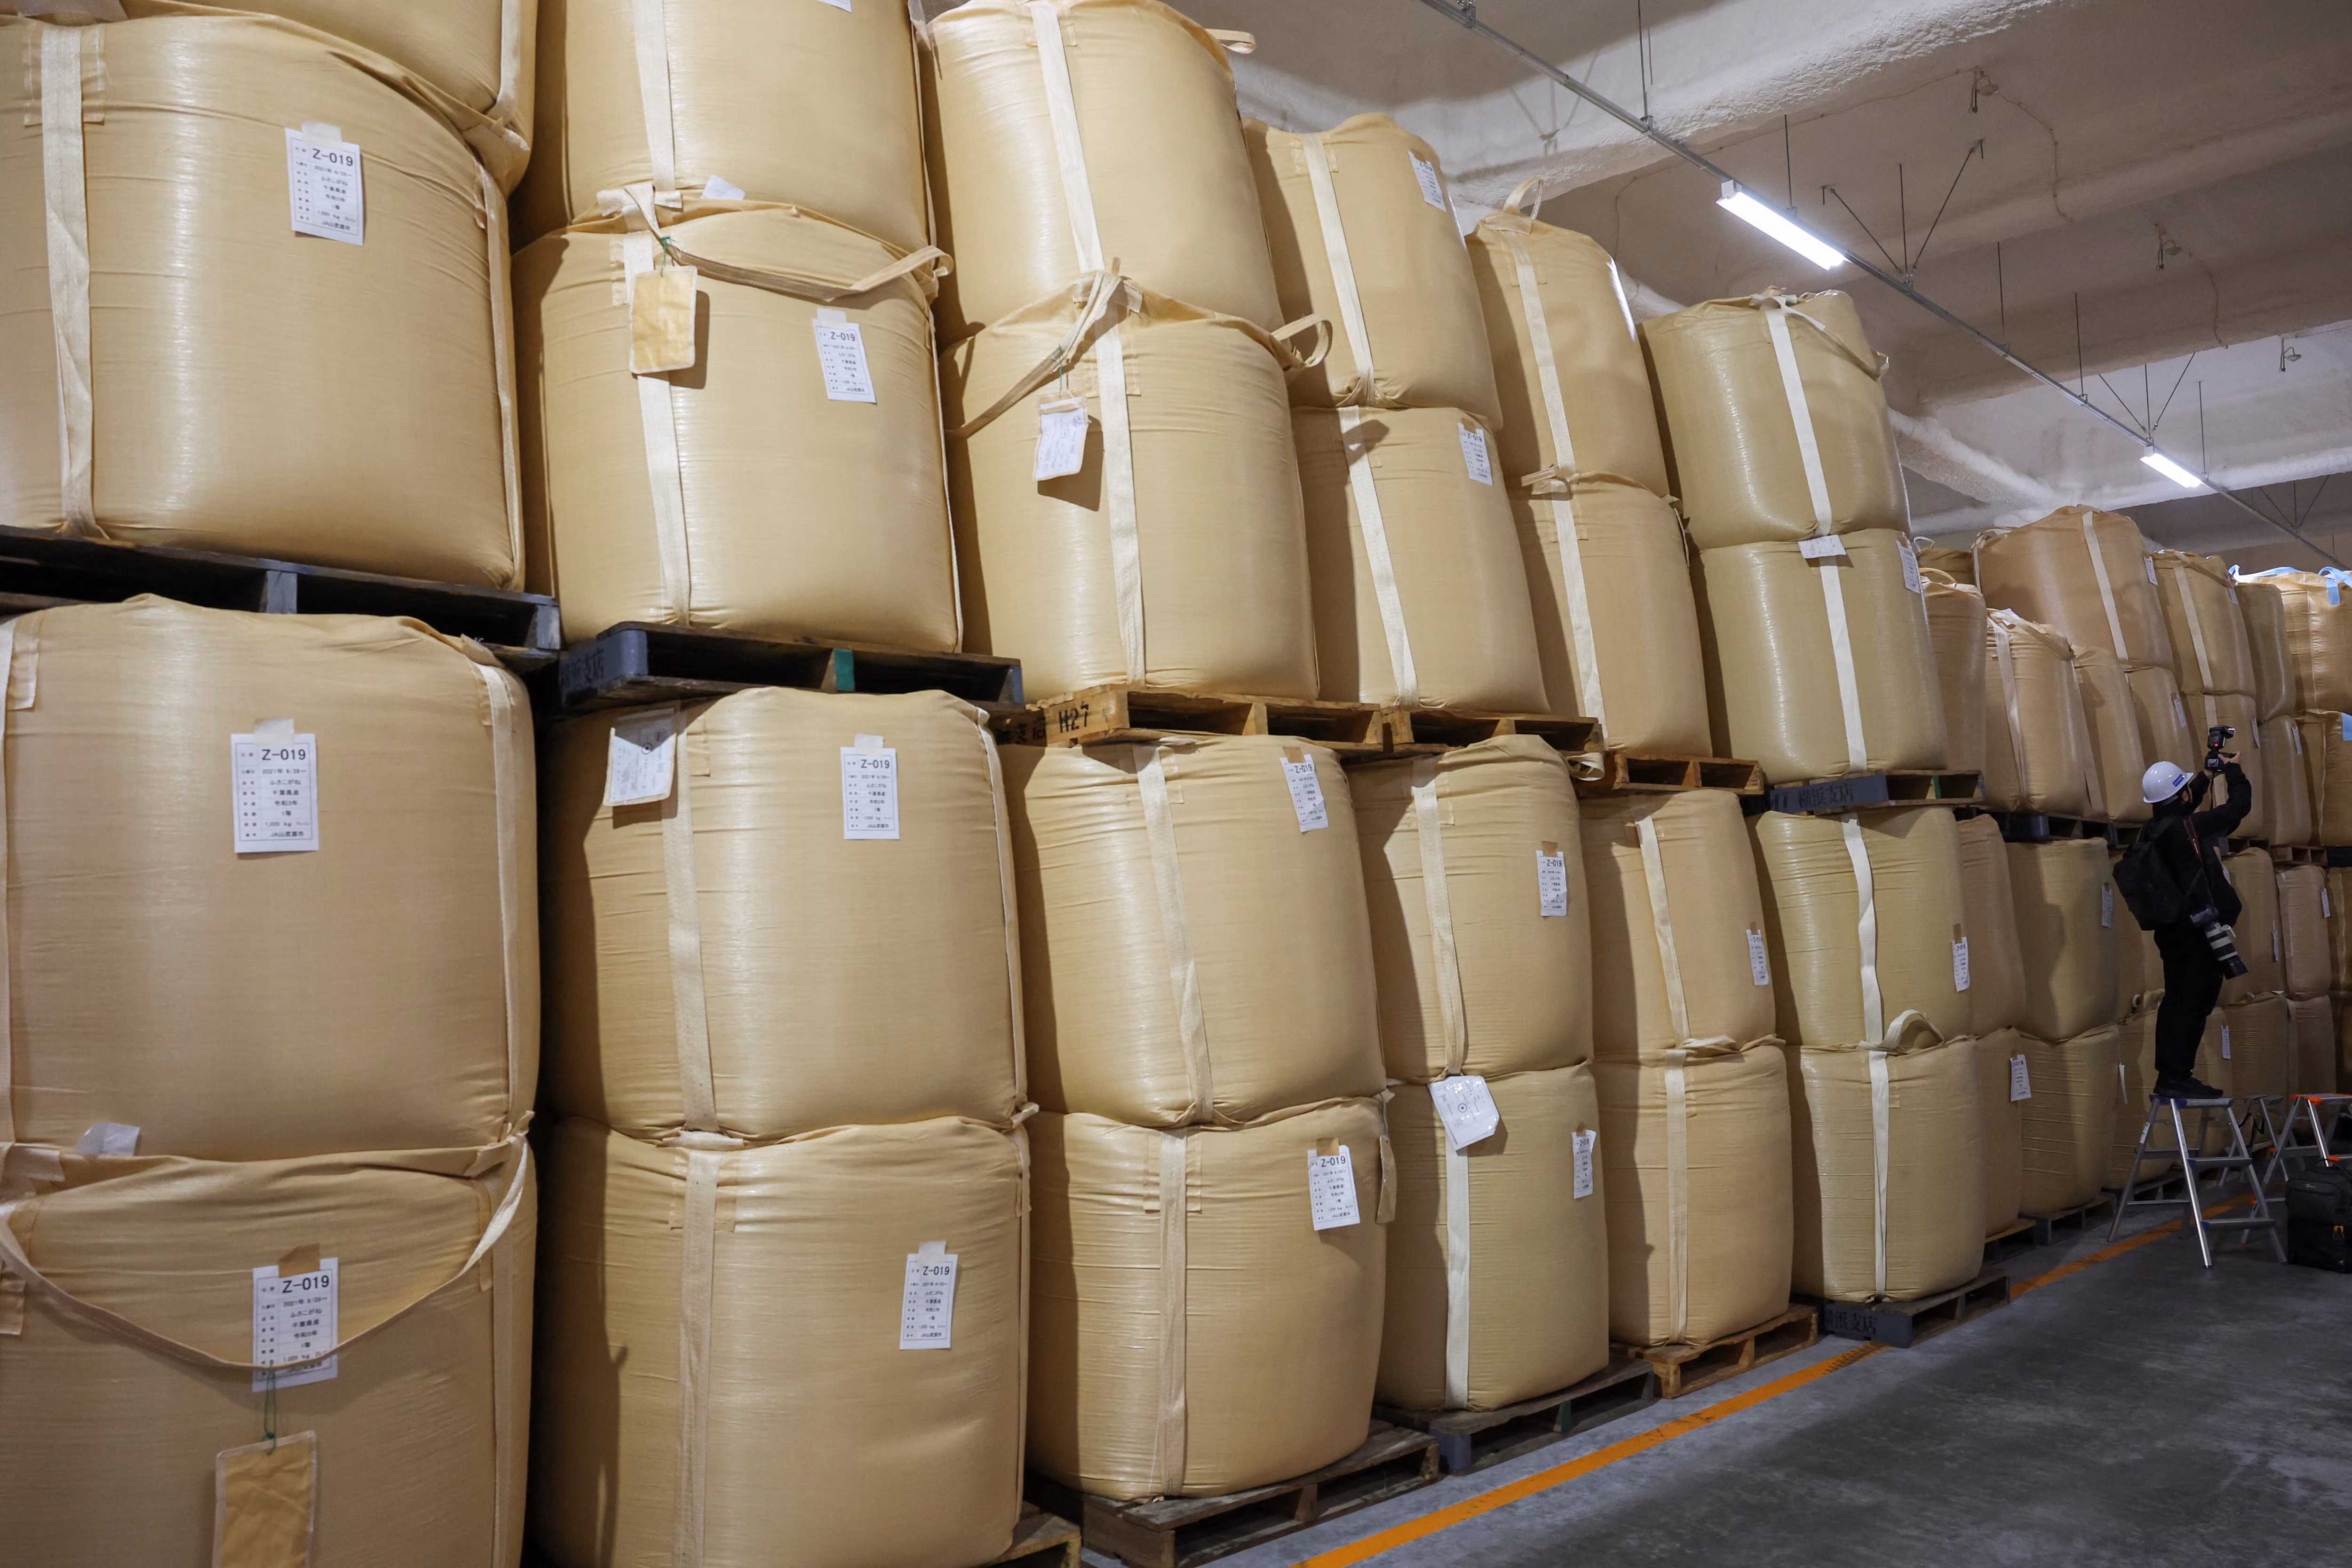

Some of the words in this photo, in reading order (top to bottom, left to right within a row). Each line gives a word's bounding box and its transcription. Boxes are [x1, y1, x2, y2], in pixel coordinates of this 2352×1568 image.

[312, 148, 353, 166] Z-019
[830, 332, 855, 341] Z-019
[1059, 701, 1089, 733] H27
[262, 749, 306, 760] Z-019
[861, 760, 890, 768] Z-019
[1295, 764, 1313, 773] Z-019
[1321, 1156, 1346, 1167] Z-019
[923, 1266, 949, 1275] Z-019
[282, 1275, 329, 1293] Z-019
